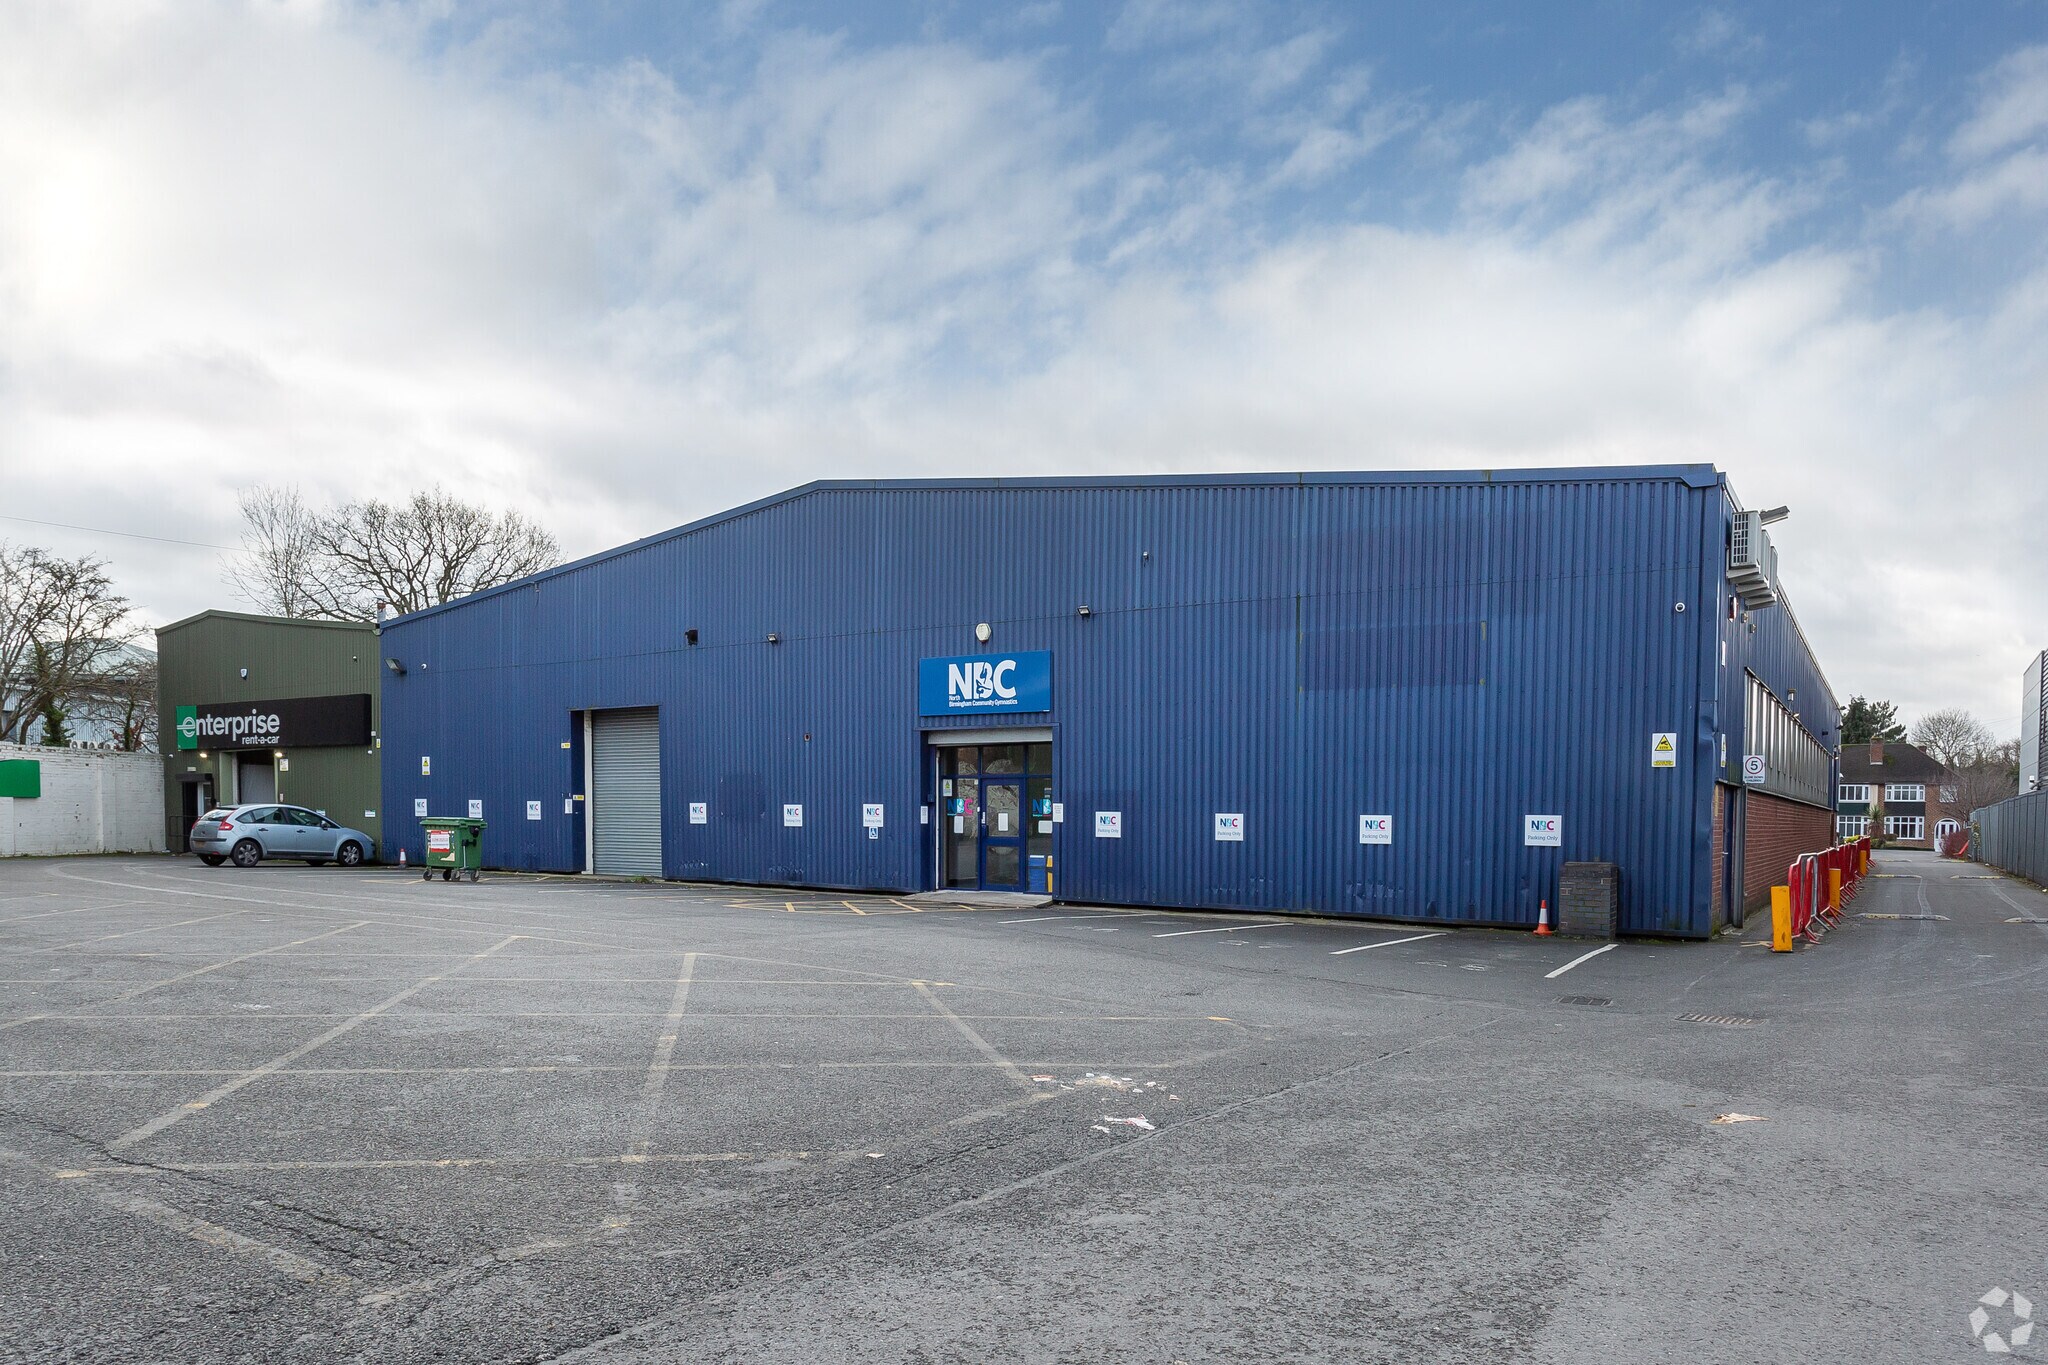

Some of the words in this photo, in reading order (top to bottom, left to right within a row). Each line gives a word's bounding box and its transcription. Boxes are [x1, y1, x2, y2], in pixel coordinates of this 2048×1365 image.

[948, 660, 1017, 699] NBC
[177, 709, 280, 742] enterprise
[241, 735, 280, 745] rent-a-car
[1750, 760, 1758, 771] 5
[947, 798, 974, 815] NBC
[1032, 799, 1052, 815] NB
